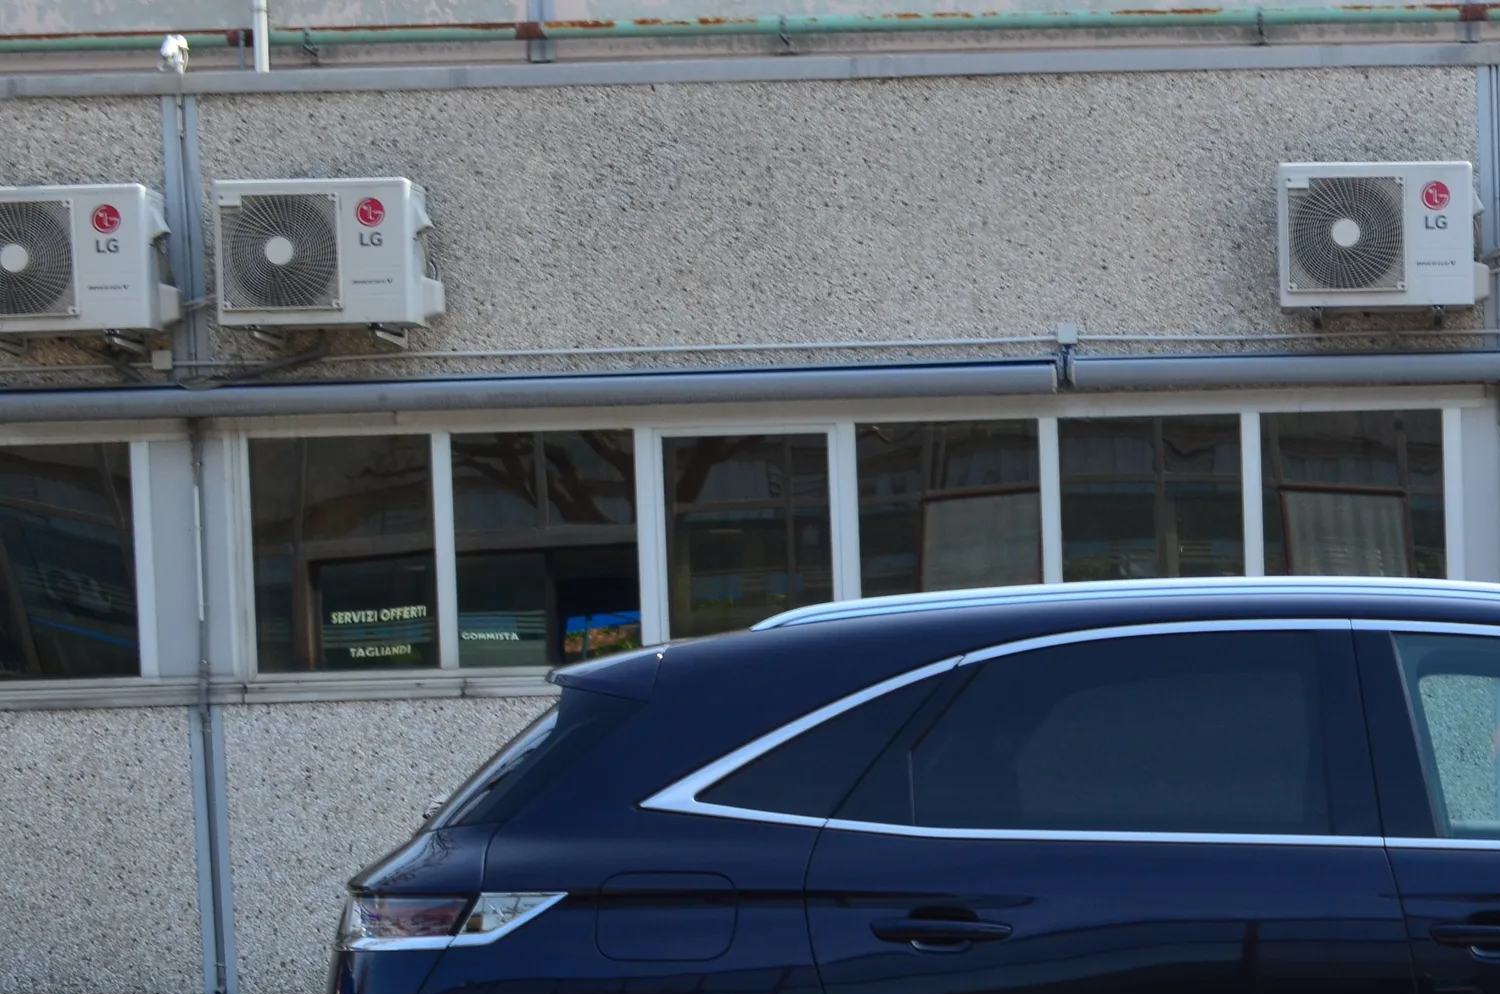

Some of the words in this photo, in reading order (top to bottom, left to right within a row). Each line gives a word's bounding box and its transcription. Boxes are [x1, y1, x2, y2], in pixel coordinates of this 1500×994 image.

[1424, 214, 1448, 230] LG
[96, 238, 120, 254] LG
[359, 231, 383, 247] LG
[331, 610, 378, 624] SERVIZI
[380, 605, 427, 621] OFFERTI
[349, 644, 412, 658] TAGLIANDI
